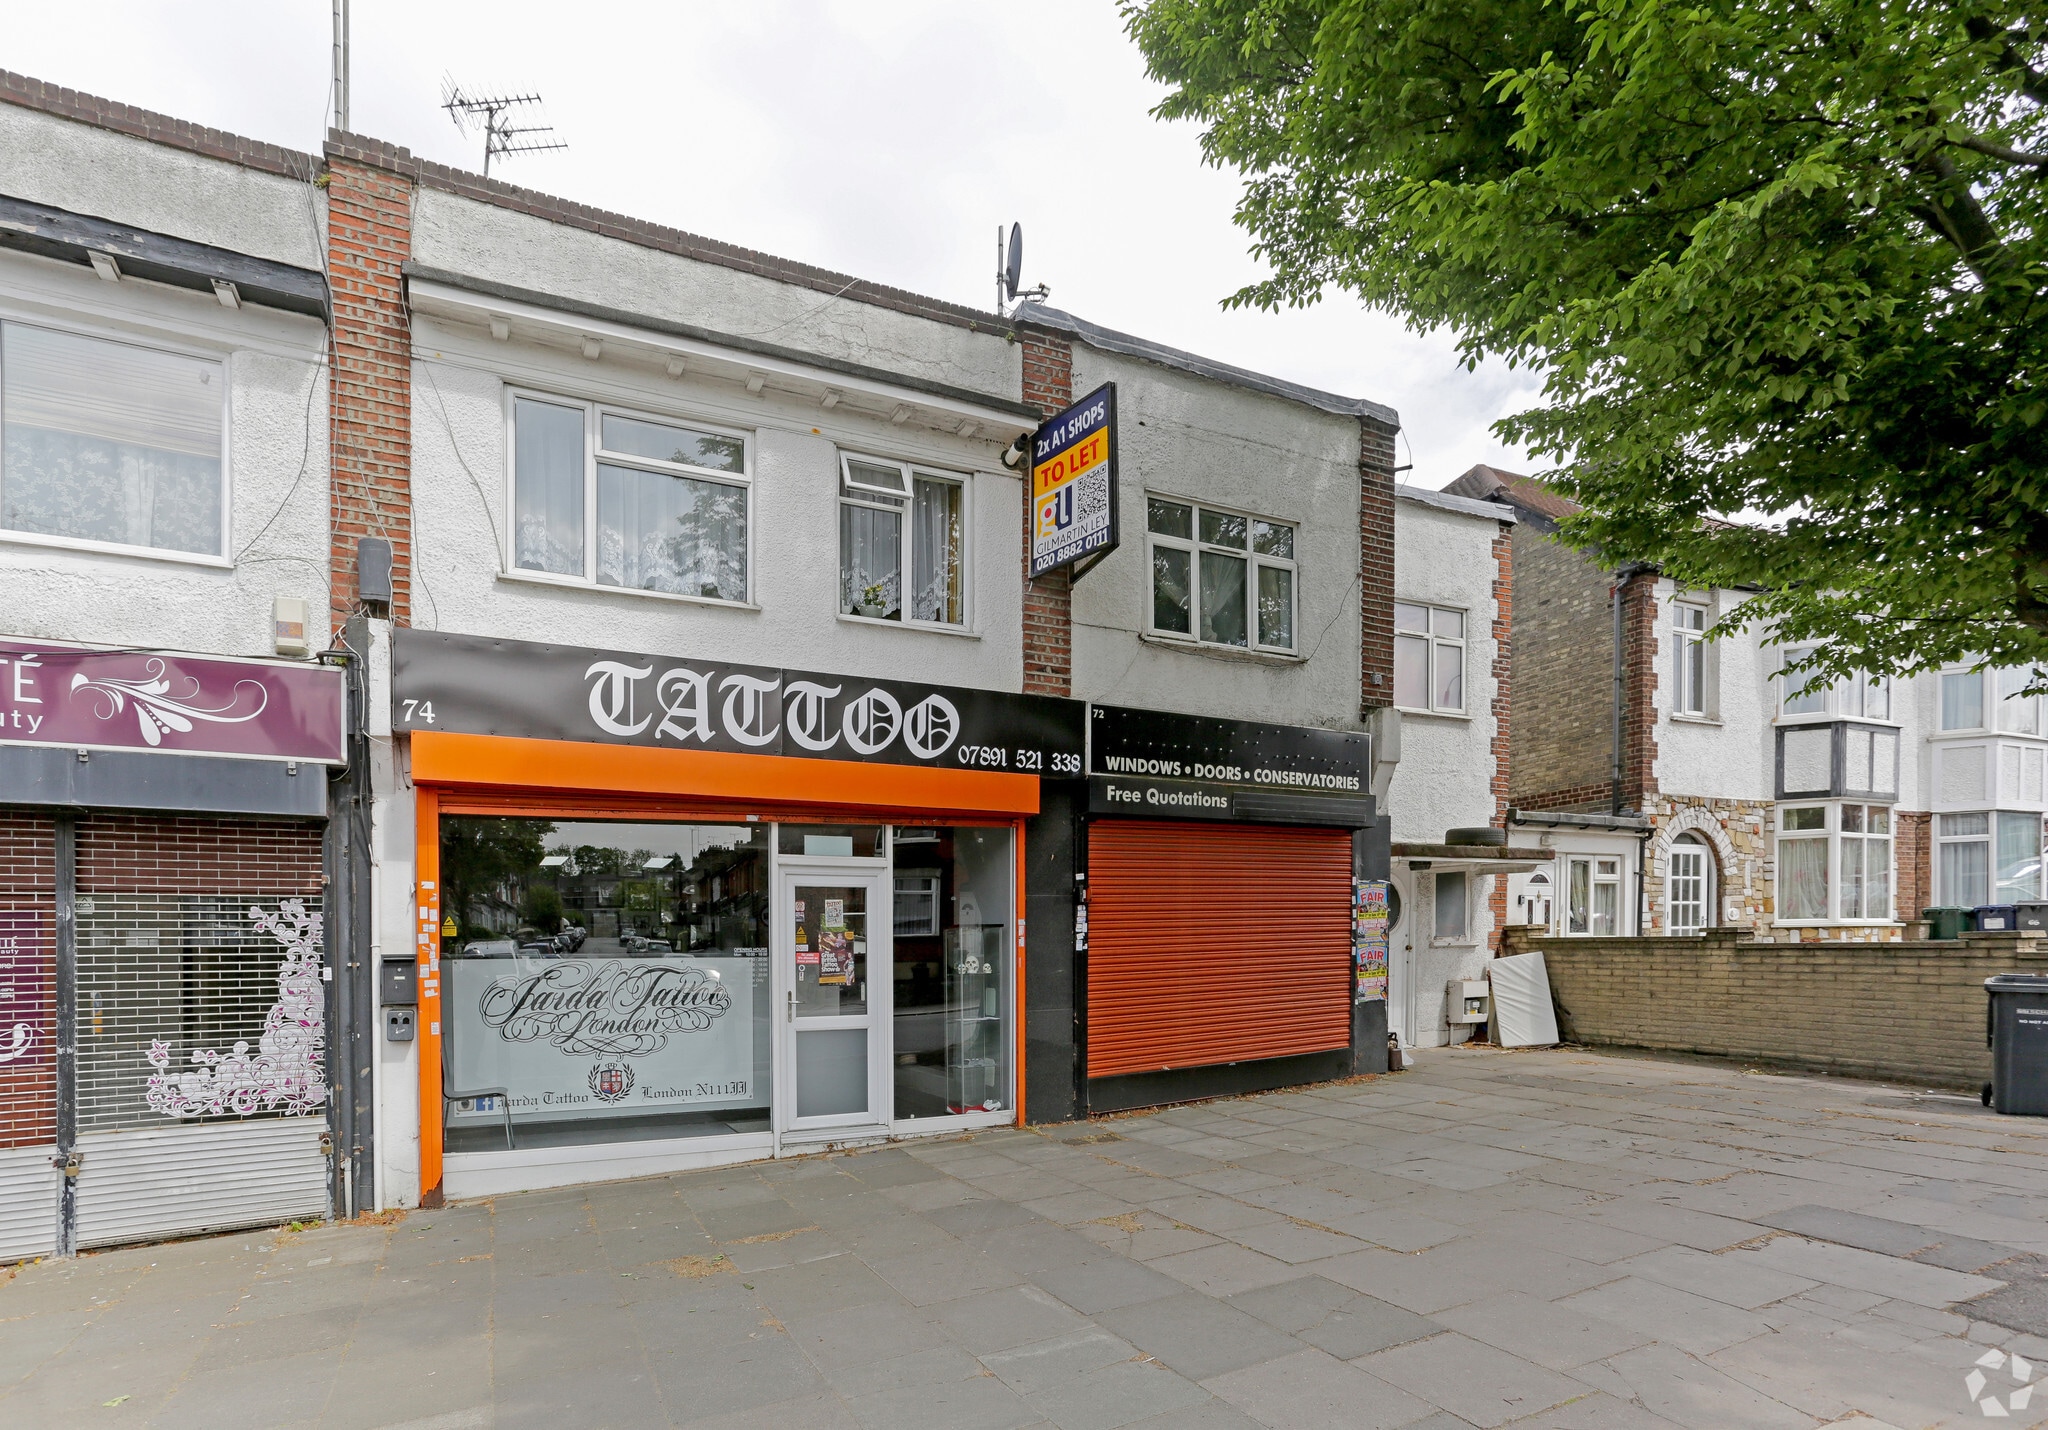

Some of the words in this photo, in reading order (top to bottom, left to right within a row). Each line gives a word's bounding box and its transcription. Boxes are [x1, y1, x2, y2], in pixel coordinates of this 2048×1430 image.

[1036, 436, 1050, 458] 2x
[1051, 423, 1066, 451] A1
[1068, 400, 1105, 439] SHOPS
[1041, 463, 1065, 488] TO
[1069, 437, 1100, 474] LET
[1036, 521, 1089, 556] GILMARTIN
[1090, 512, 1108, 531] LEY
[1036, 550, 1055, 571] 020
[1056, 538, 1083, 563] 8882
[1085, 527, 1108, 550] 0111
[401, 698, 436, 724] 74
[584, 660, 960, 759] TATTOO
[1092, 708, 1105, 719] 72
[958, 744, 1008, 767] 07891
[1015, 749, 1043, 770] 521
[1050, 752, 1081, 772] 338
[1105, 755, 1181, 776] WINDOWS
[1194, 764, 1242, 780] DOORS
[1253, 768, 1360, 790] CONSERVATORIES
[1106, 785, 1141, 802] Free
[1146, 788, 1228, 808] Quotations
[1360, 892, 1384, 904] FAIR
[1360, 950, 1384, 963] FAIR
[611, 964, 730, 1014] Tattoo
[543, 1091, 589, 1105] Tattoo
[641, 1086, 692, 1099] London
